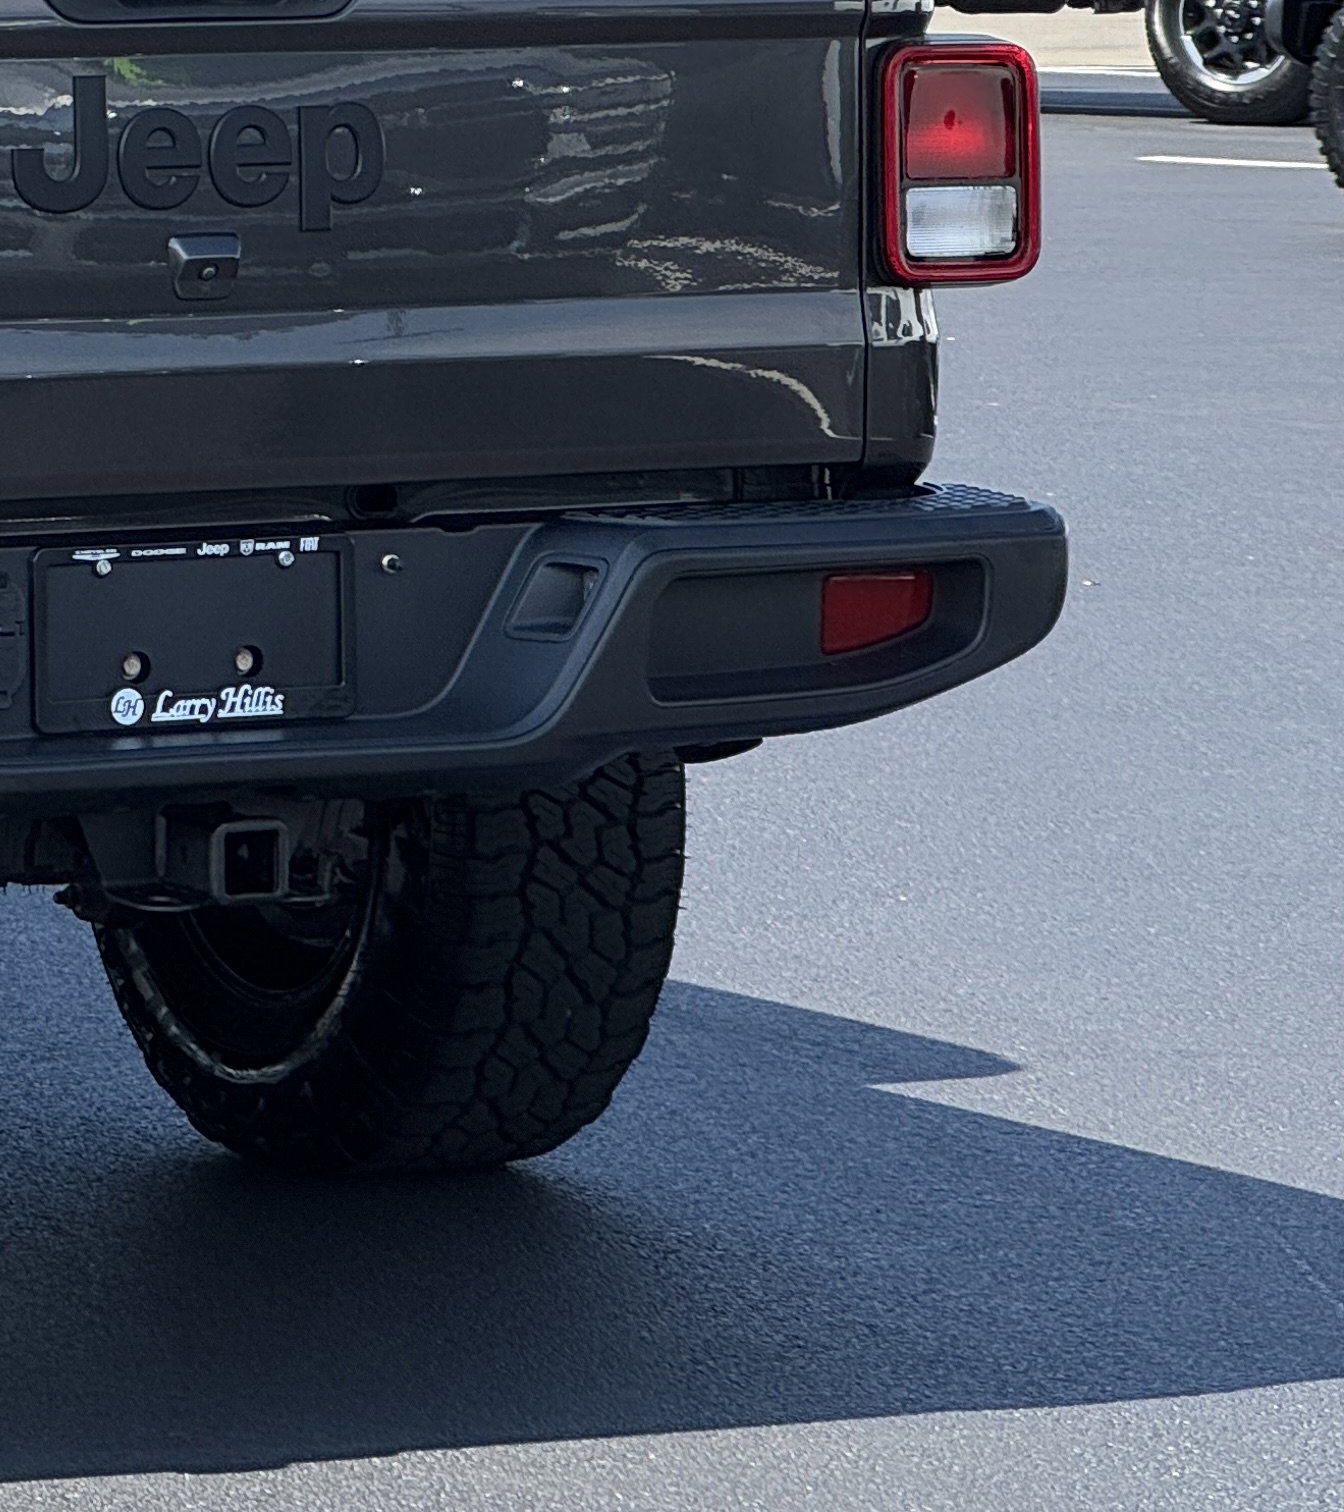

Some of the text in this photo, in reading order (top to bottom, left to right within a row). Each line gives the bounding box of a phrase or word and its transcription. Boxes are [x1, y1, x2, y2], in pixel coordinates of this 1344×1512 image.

[11, 74, 386, 232] Jeep
[131, 547, 187, 557] DODGE
[196, 541, 231, 557] Jeep
[255, 540, 291, 551] RAM
[151, 690, 217, 723] Larry
[217, 684, 285, 718] Hillis
